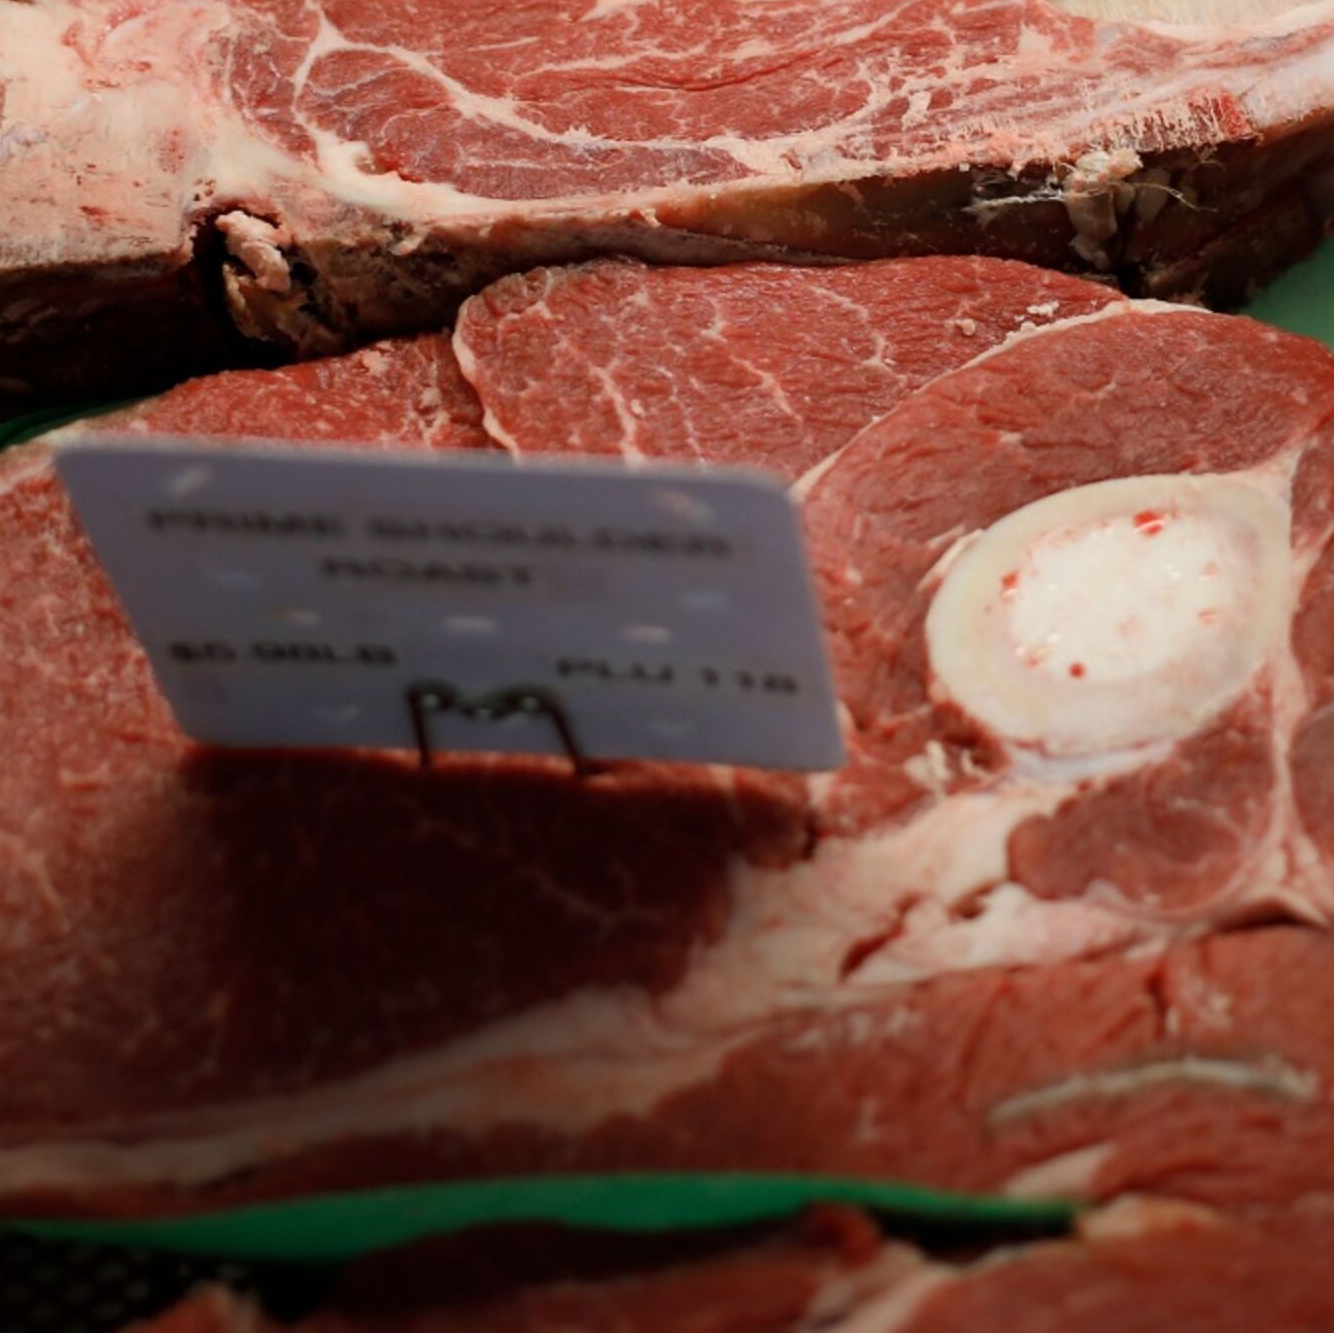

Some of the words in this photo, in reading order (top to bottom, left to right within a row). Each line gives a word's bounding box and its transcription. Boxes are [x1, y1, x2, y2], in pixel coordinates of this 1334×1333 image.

[146, 506, 346, 538] PRIME
[320, 555, 534, 587] ROAST
[555, 656, 675, 686] PLU
